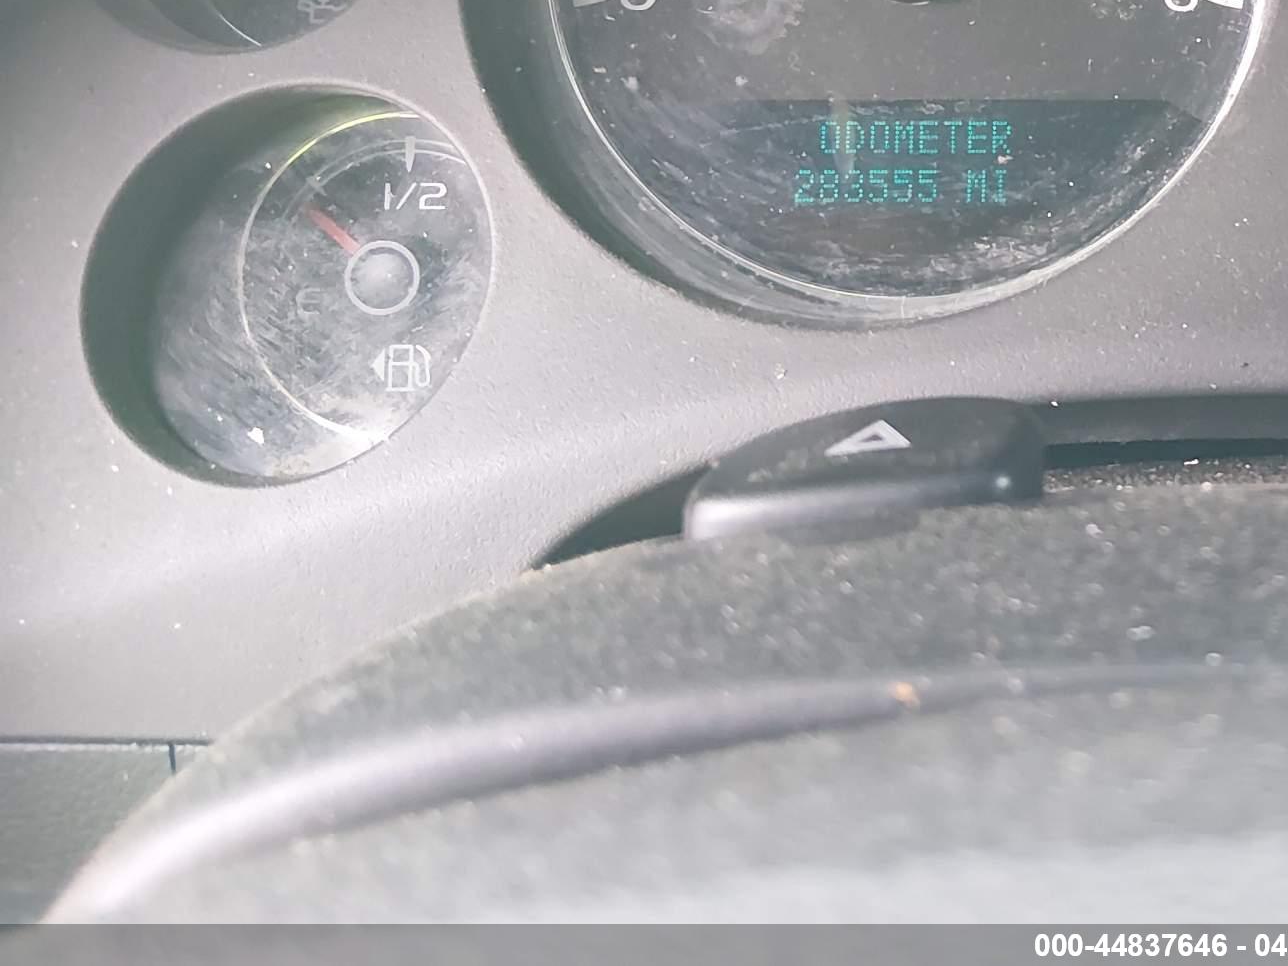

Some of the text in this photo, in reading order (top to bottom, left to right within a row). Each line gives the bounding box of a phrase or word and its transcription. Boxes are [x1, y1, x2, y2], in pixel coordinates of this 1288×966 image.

[820, 121, 1012, 153] ODOMETER
[384, 182, 447, 210] 1/2
[795, 169, 1007, 202] 283555 MI
